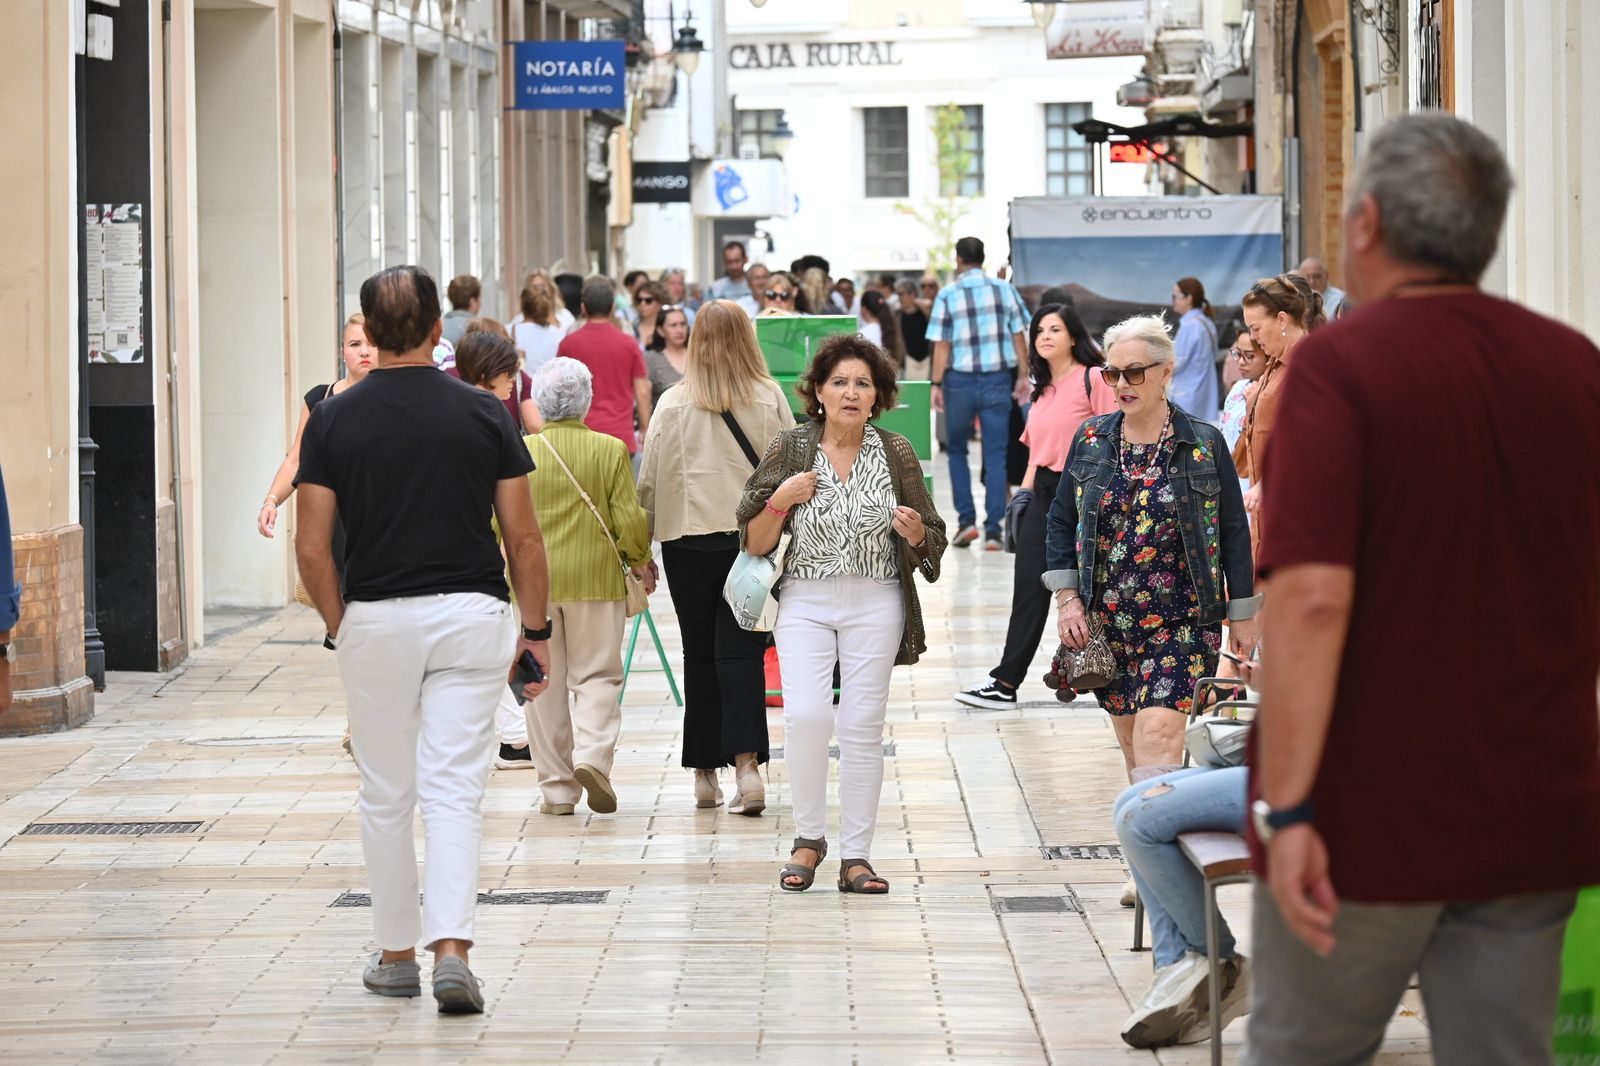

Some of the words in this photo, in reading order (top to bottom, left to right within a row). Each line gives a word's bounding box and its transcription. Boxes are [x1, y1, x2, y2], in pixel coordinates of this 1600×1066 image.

[729, 43, 796, 69] CAJA
[806, 41, 902, 67] RURAL
[526, 56, 615, 77] NOTARÍA
[578, 85, 613, 95] NUEVO
[1100, 207, 1212, 221] encuentro
